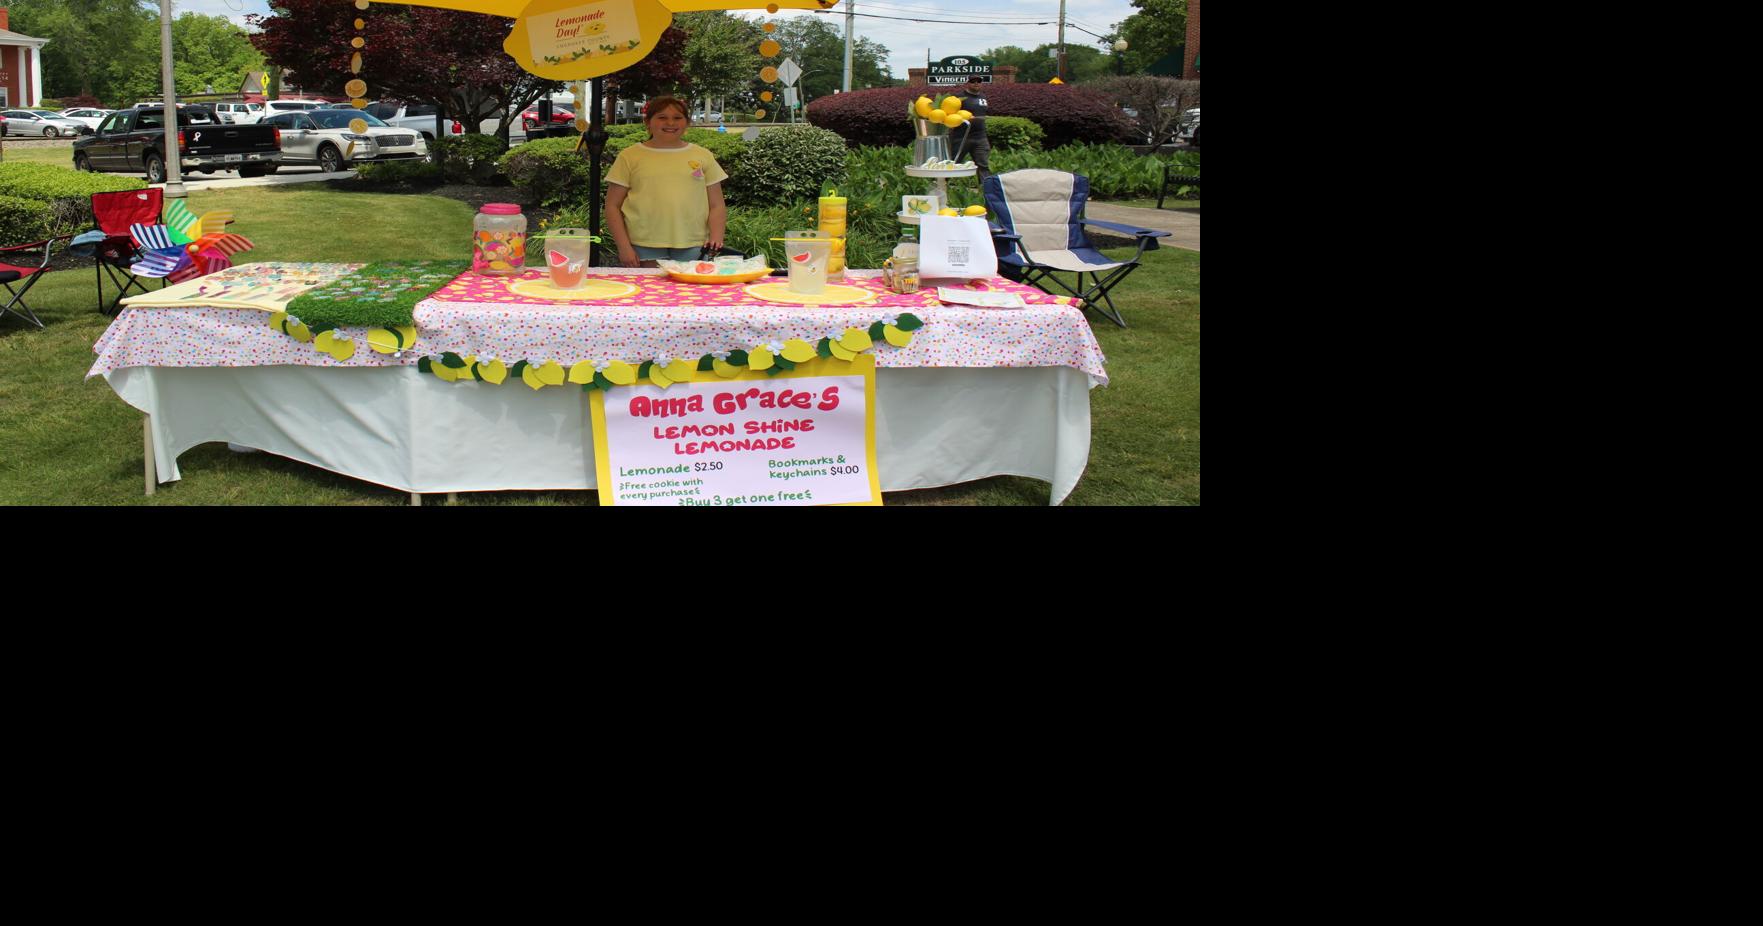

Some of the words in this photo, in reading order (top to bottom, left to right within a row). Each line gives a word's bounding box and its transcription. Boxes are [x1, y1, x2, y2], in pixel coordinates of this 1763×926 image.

[555, 9, 605, 28] Lemonade
[556, 25, 581, 39] Day!
[629, 394, 705, 418] Anna
[653, 422, 735, 439] LEMON
[674, 436, 796, 455] LEMONADE
[620, 464, 690, 477] Lemonade
[694, 461, 723, 472] $2.50
[768, 456, 834, 468] Bookmarks
[836, 454, 846, 464] &
[830, 465, 859, 476] $4.00
[625, 481, 646, 490] Free
[649, 479, 680, 488] cookie
[682, 478, 704, 486] with
[620, 492, 648, 500] every
[650, 488, 695, 500] purchase
[686, 497, 711, 506] Buy
[713, 495, 722, 506] 3
[725, 496, 747, 506] get
[750, 494, 775, 503] one
[777, 490, 804, 500] free
